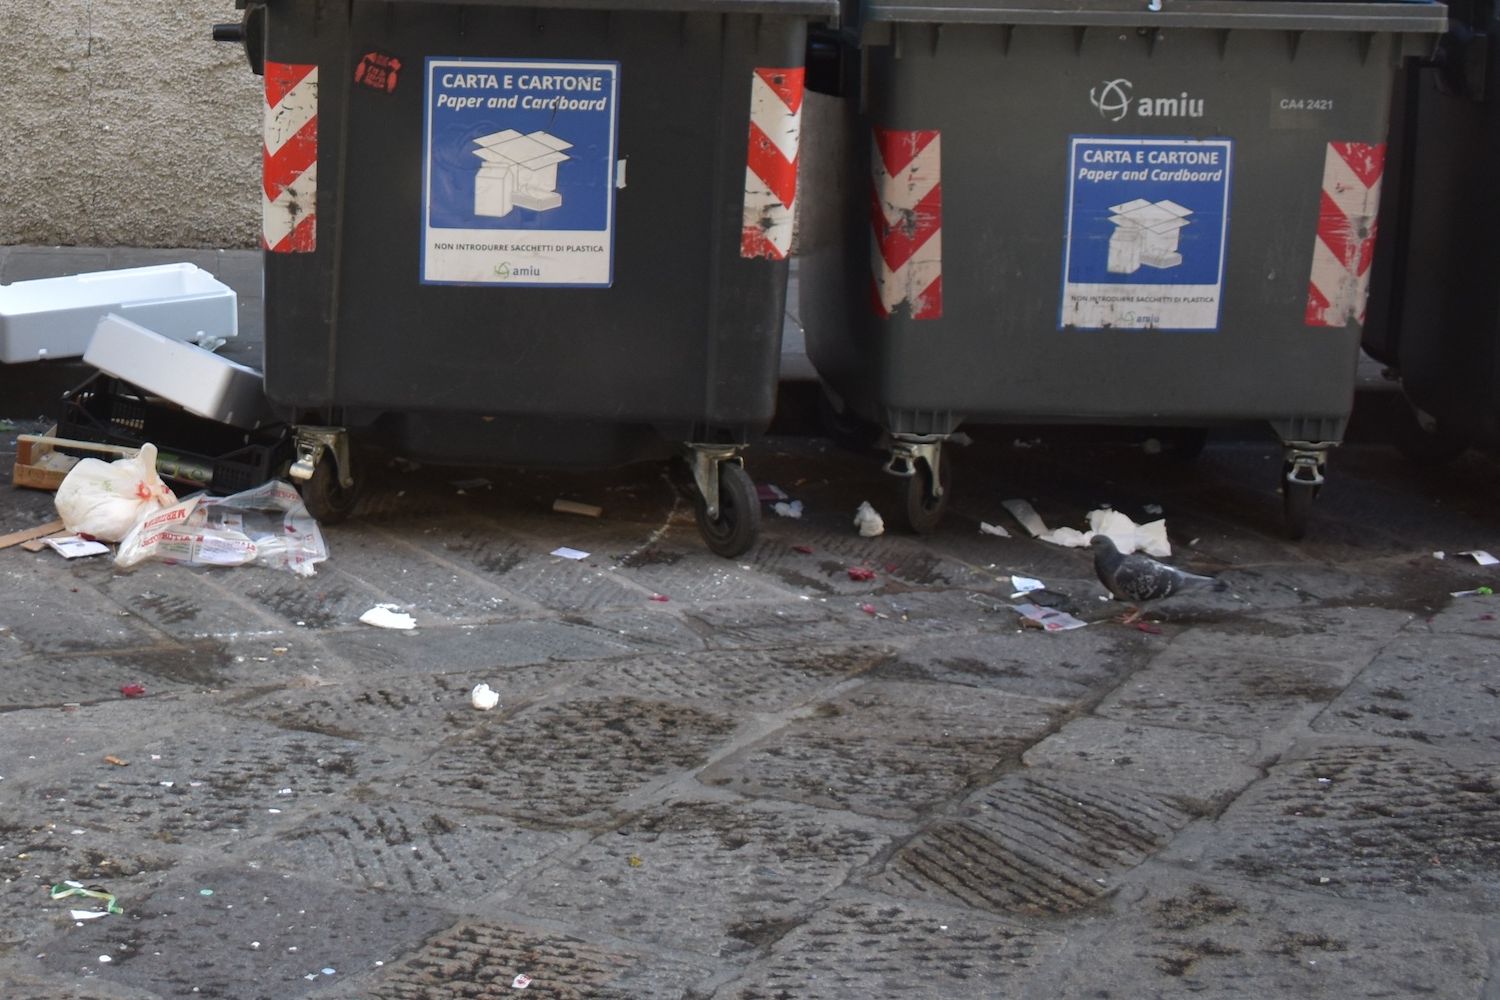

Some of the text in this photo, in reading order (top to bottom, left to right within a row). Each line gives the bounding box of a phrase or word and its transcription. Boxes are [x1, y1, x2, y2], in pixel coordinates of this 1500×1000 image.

[442, 74, 602, 91] CARTA E CARTONE
[437, 94, 607, 111] Paper and Cardboard
[1137, 92, 1204, 118] amiu
[1306, 99, 1333, 110] 2421
[1082, 150, 1219, 165] CARTA E CARTONE
[1078, 167, 1222, 183] Paper and Cardboard
[456, 243, 508, 251] INTRODURRE
[510, 244, 554, 252] SACCHETTI
[566, 245, 604, 253] PLASTICA
[512, 265, 540, 276] amiu
[1136, 314, 1160, 324] amiu
